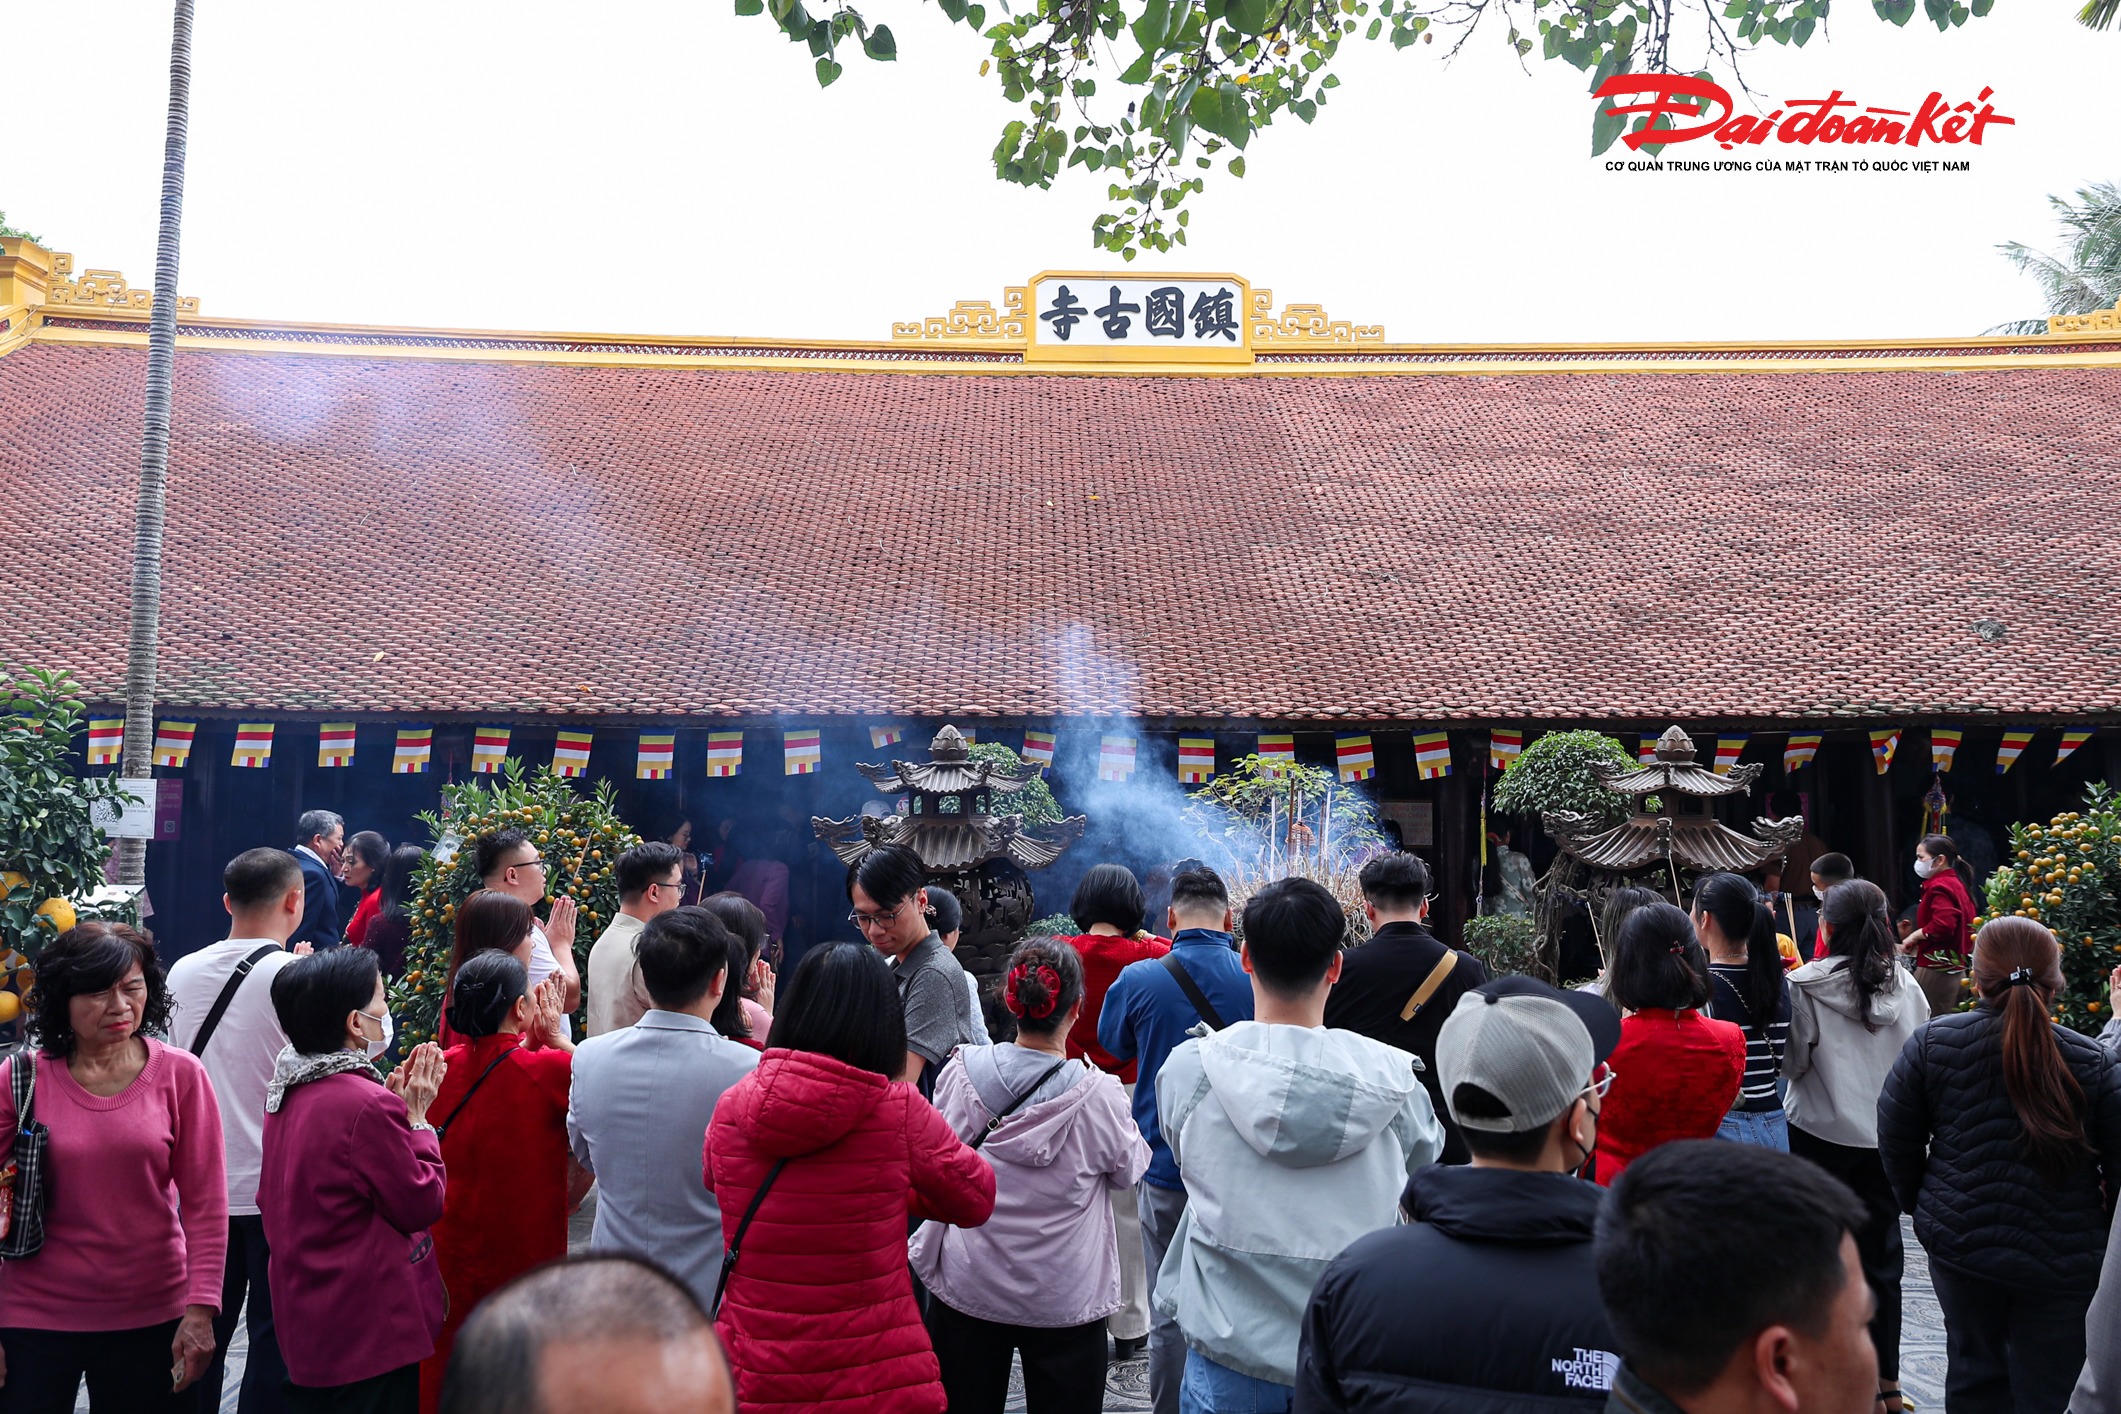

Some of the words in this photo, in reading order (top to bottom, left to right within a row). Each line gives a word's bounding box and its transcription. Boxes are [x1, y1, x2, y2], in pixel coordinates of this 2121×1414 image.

[1573, 1347, 1603, 1363] THE
[1551, 1358, 1602, 1376] NORTH
[1565, 1372, 1603, 1389] FACE
